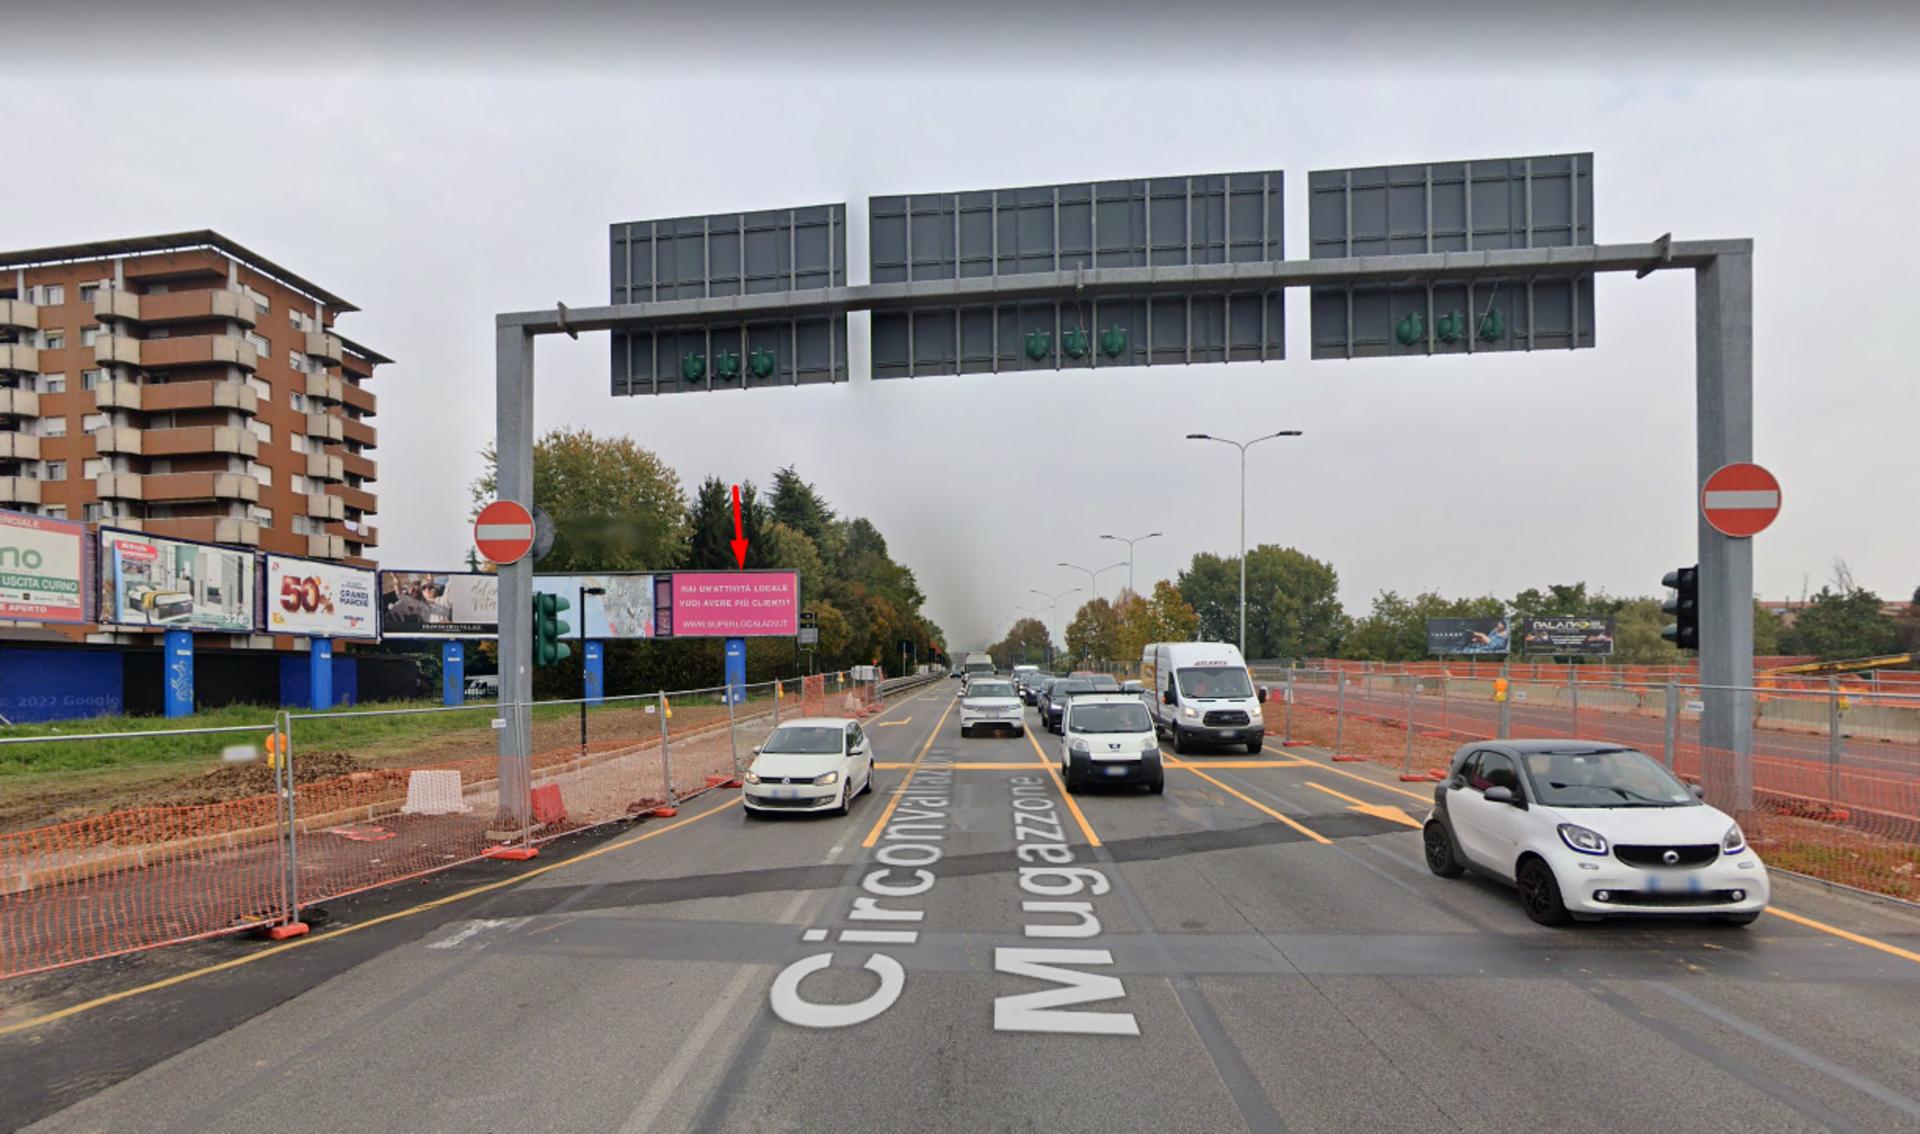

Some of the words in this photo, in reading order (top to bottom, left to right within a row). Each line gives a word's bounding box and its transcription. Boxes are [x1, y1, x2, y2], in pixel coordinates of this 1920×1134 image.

[2, 575, 40, 589] USCITA
[41, 578, 78, 592] CURNO
[681, 585, 696, 593] HAI
[754, 584, 788, 593] LOCALE
[679, 599, 701, 607] VUOI
[703, 599, 732, 607] AVERE
[734, 597, 750, 607] PIÙ
[8, 604, 48, 614] APERTO
